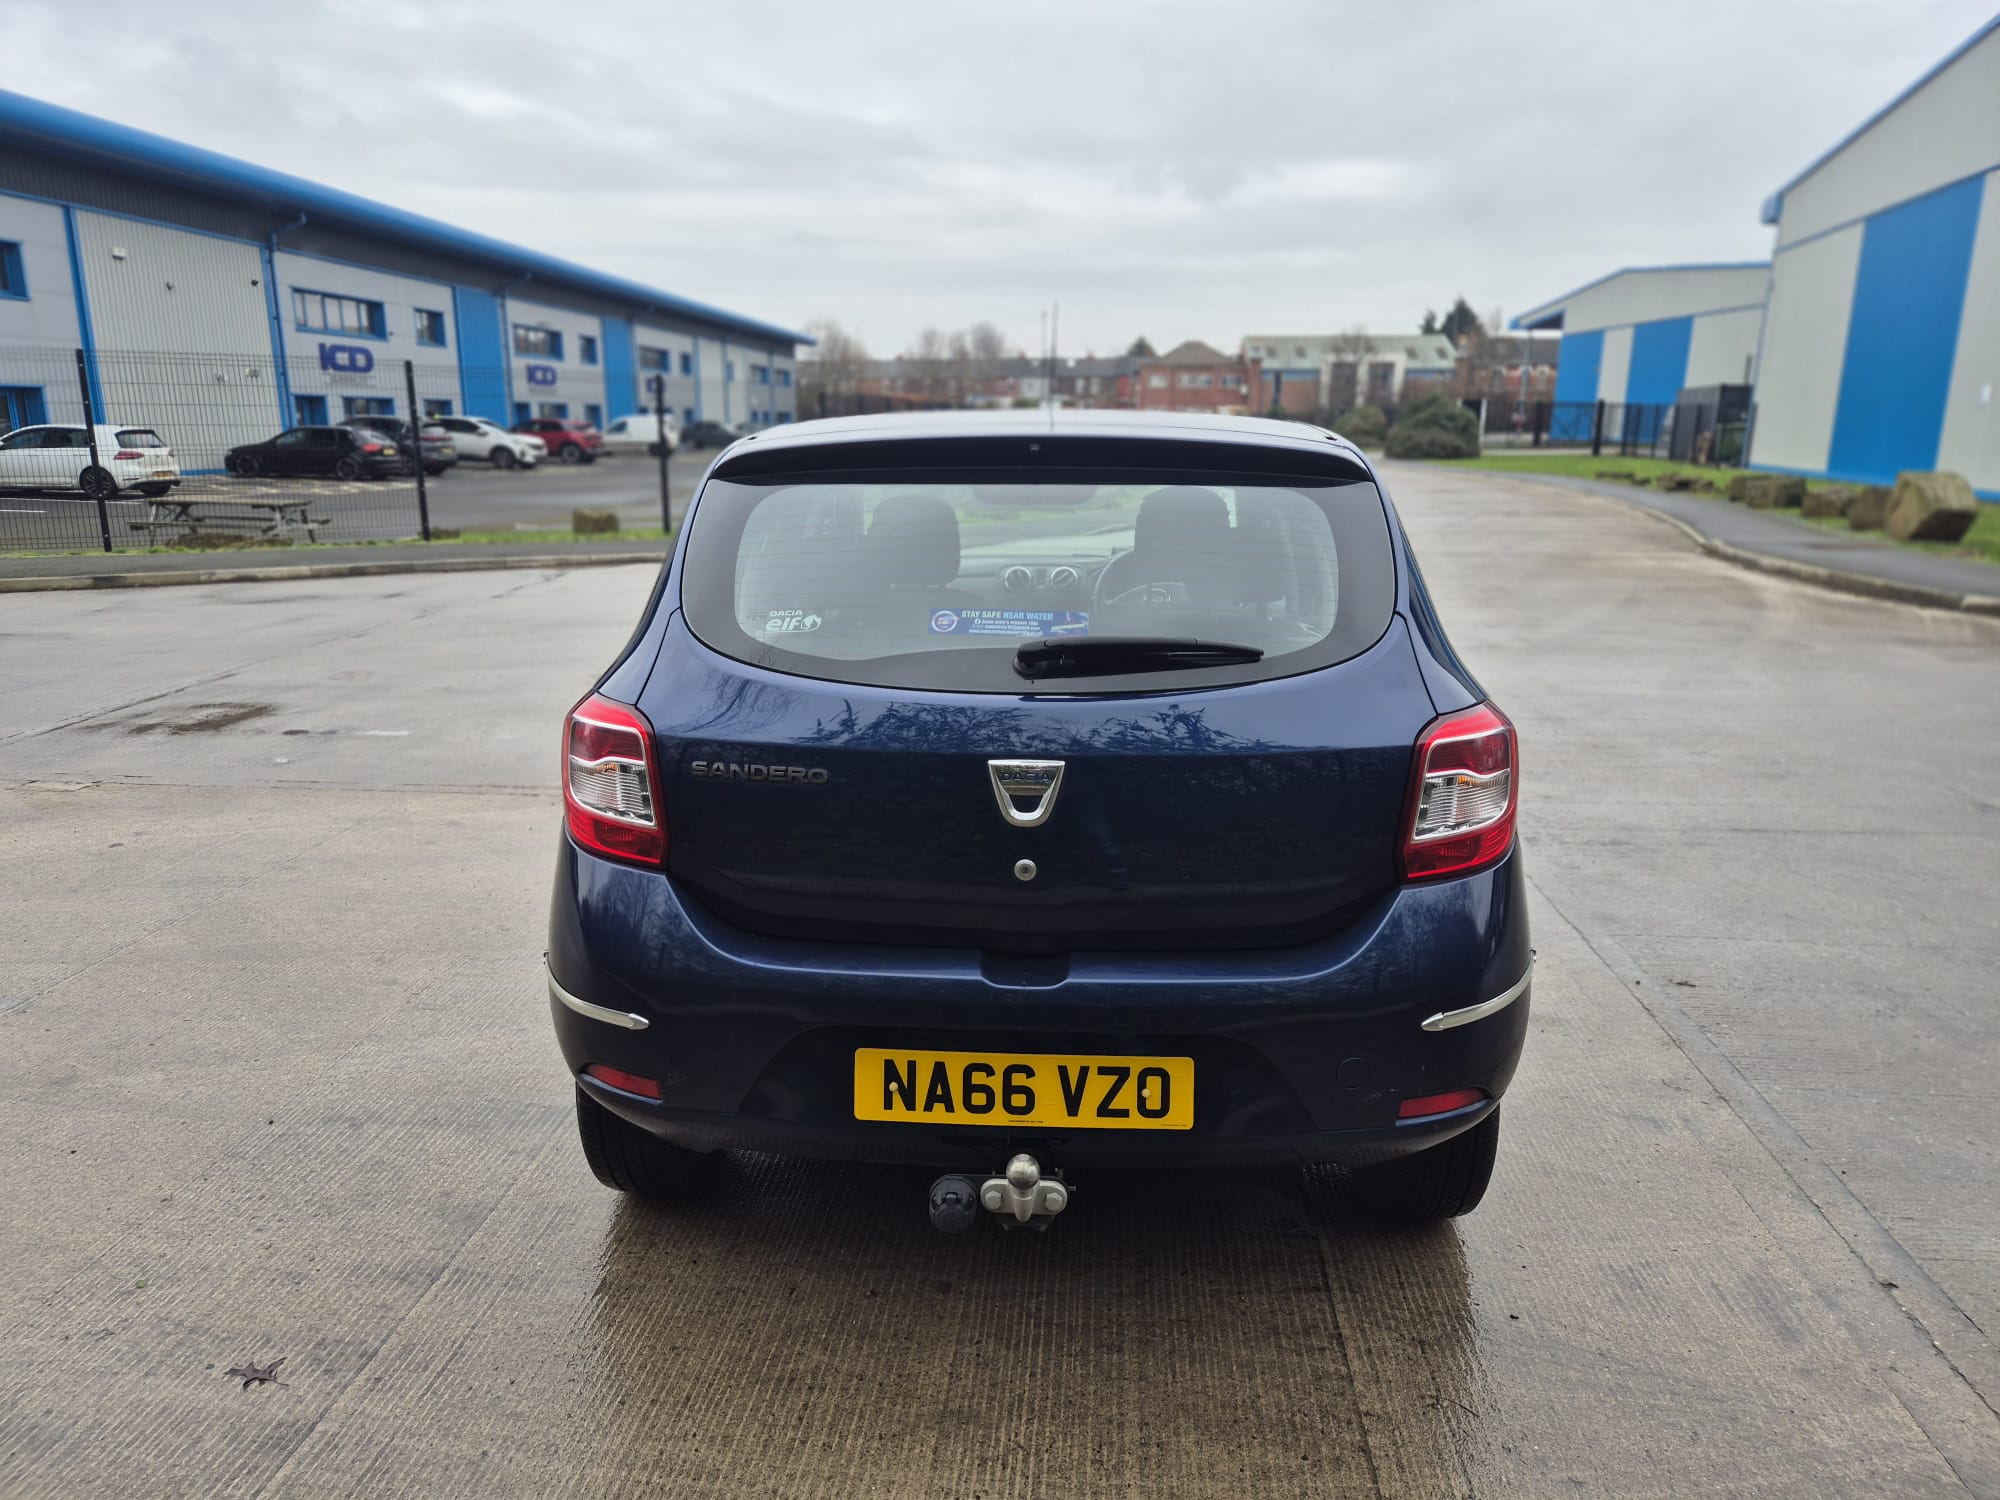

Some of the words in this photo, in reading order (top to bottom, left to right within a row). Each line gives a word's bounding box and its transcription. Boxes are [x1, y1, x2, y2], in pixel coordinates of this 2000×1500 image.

[961, 610, 981, 618] STAY
[1003, 611, 1025, 620] NEAR
[1026, 612, 1054, 621] WATER
[766, 617, 802, 631] elf
[691, 760, 829, 785] SANDERO
[1001, 772, 1051, 782] DACIA
[883, 1058, 1036, 1116] NA66
[1057, 1064, 1171, 1119] VZO
